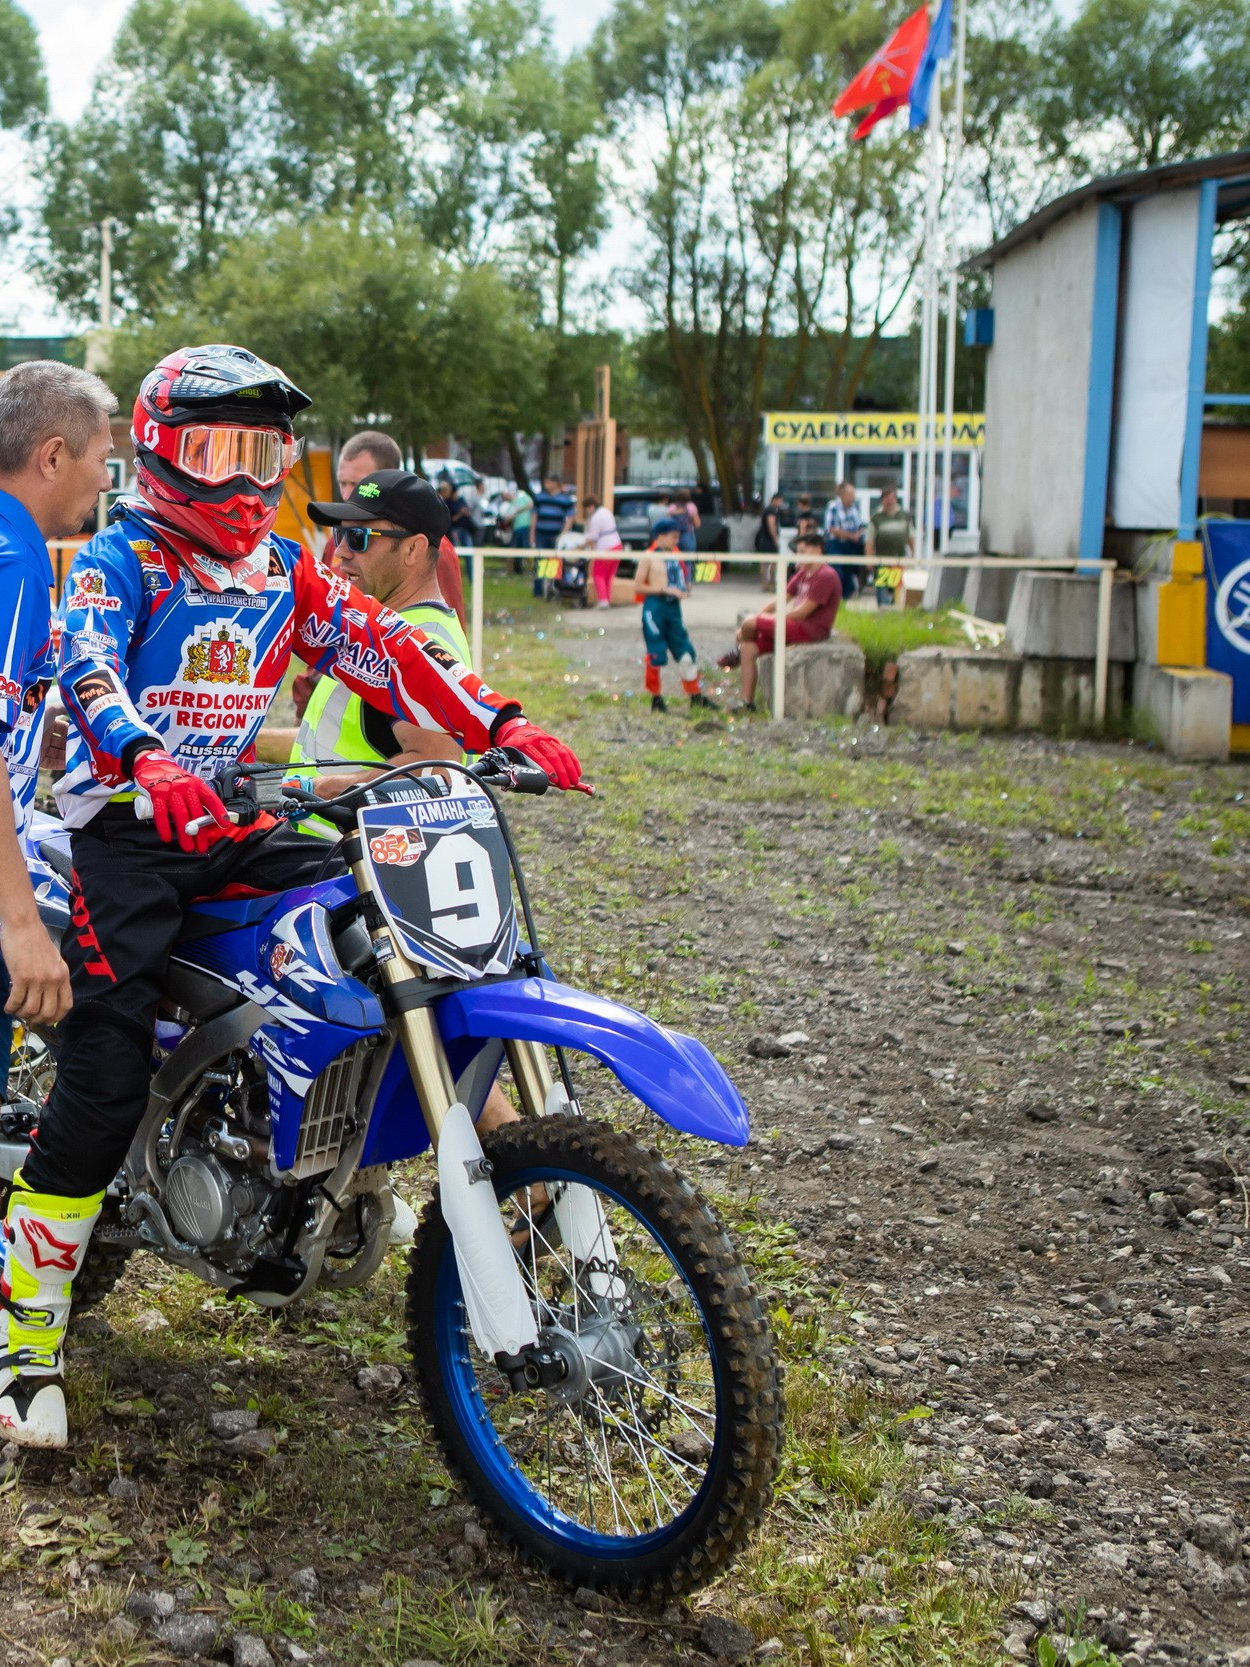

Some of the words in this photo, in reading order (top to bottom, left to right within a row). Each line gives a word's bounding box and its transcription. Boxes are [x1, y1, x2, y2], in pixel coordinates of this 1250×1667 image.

[237, 389, 260, 397] SHOEI
[773, 417, 916, 442] СУДЕЙСКАЯ
[536, 558, 561, 579] 18
[695, 562, 718, 583] 19
[875, 567, 903, 588] 20
[208, 592, 268, 608] УРАЛТРАНСТРОМ
[303, 612, 391, 678] NIAARA
[356, 672, 388, 687] ВОДА
[146, 690, 271, 711] SVERDLOVSKY
[176, 710, 248, 730] REGION
[178, 743, 239, 757] RUSSIA
[387, 788, 432, 803] YAMAHA
[406, 802, 469, 826] YAMAHA
[370, 839, 402, 864] 85
[424, 833, 501, 949] 9
[70, 867, 118, 983] COTT
